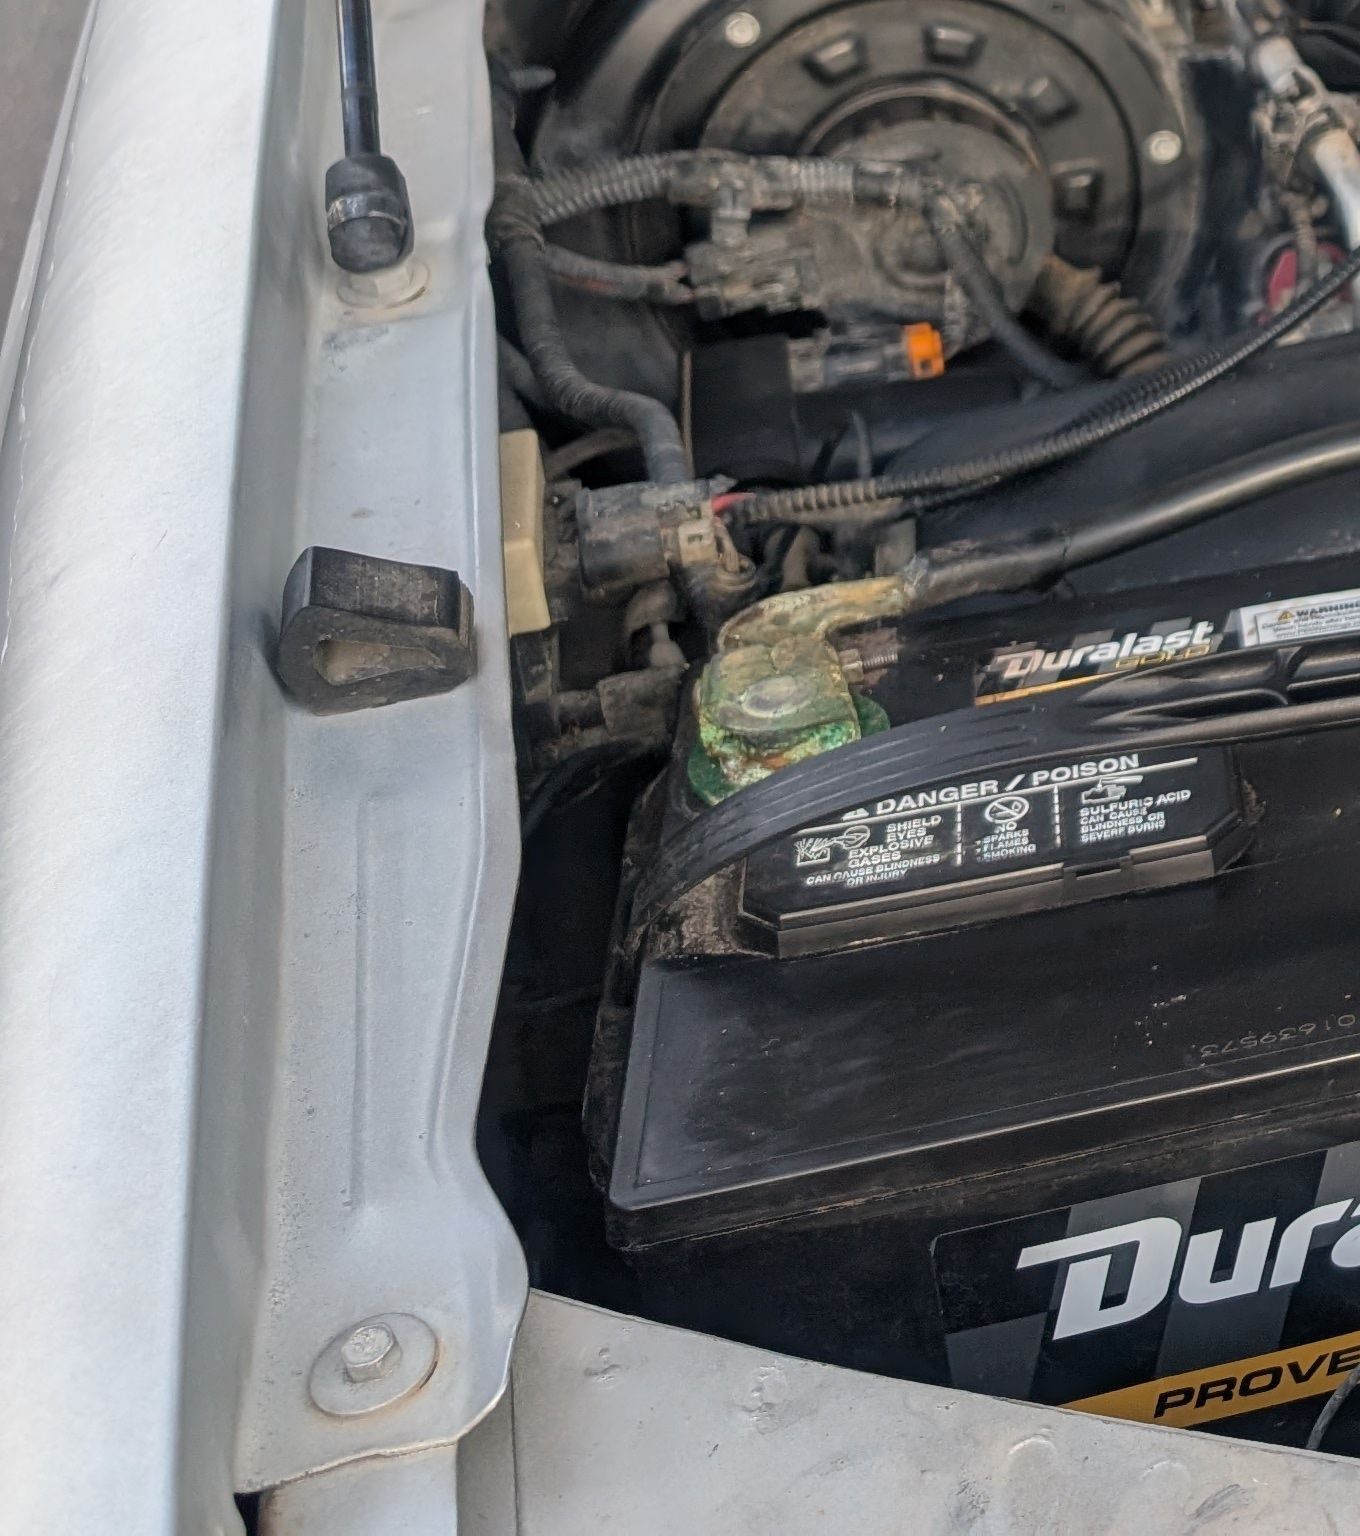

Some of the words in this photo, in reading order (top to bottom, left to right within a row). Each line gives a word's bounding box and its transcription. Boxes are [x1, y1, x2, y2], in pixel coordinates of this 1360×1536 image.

[988, 620, 1215, 681] Duralast
[876, 779, 1000, 815] DANGER
[1031, 753, 1140, 786] POISON
[1079, 796, 1154, 817] SULFURIC
[1156, 789, 1192, 807] ACID
[886, 814, 942, 834] SHIELD
[1080, 813, 1107, 825] CAN
[1109, 807, 1148, 821] CAUSE
[1080, 816, 1144, 834] BLINDNESS
[1147, 811, 1165, 822] OR
[886, 827, 927, 843] EYES
[994, 821, 1018, 833] NO
[1127, 819, 1167, 836] BURNS
[848, 835, 934, 861] EXPLOSIVE
[849, 850, 902, 869] GASES
[806, 874, 832, 886] CAN
[833, 866, 873, 882] CAUSE
[875, 854, 941, 874] BLINDNESS
[846, 876, 863, 887] OR
[866, 868, 909, 884] INJURY
